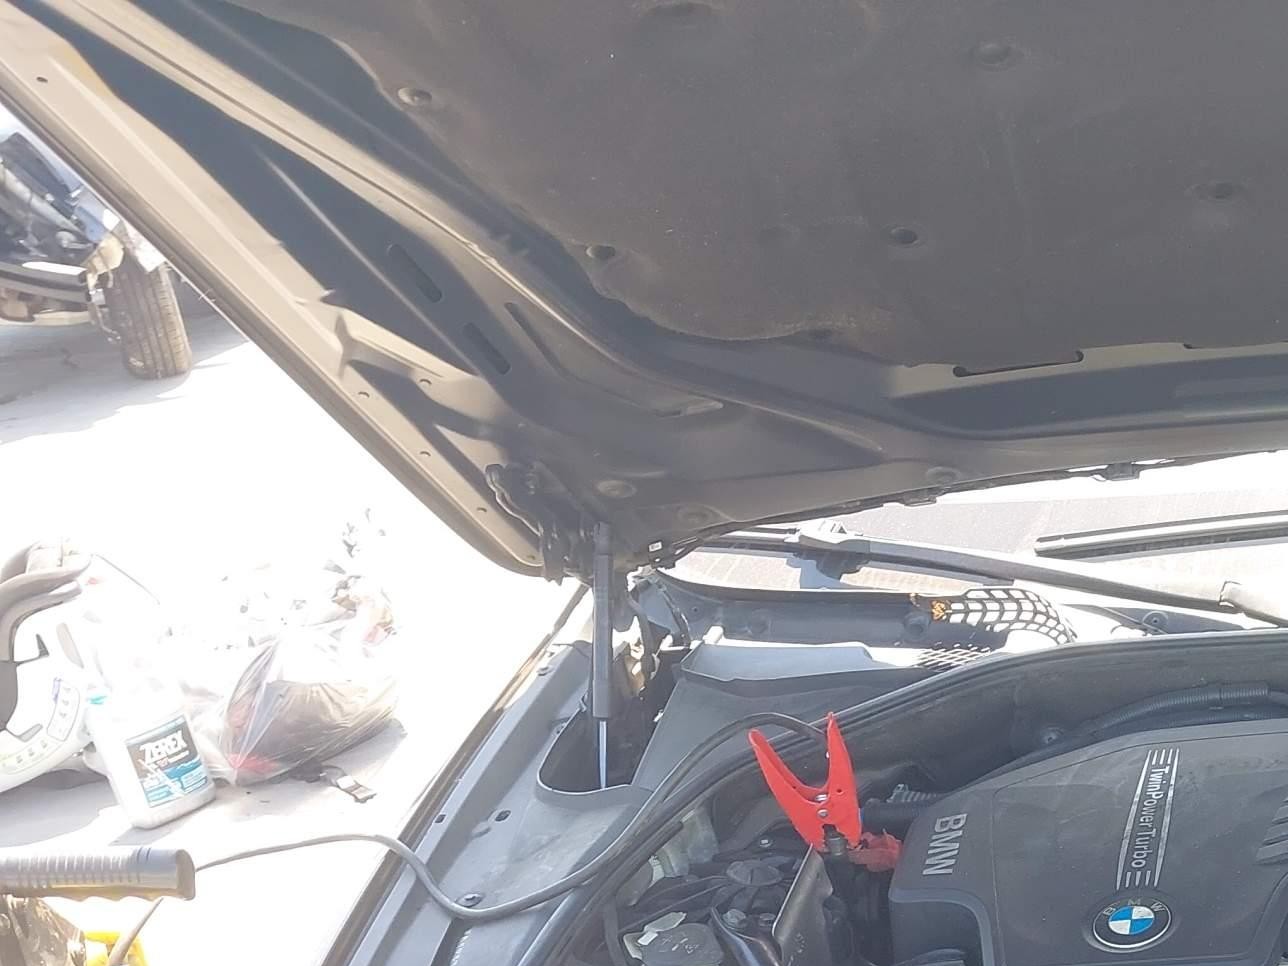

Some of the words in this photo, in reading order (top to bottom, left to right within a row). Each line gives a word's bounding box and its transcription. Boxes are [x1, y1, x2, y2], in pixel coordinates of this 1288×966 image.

[138, 729, 189, 764] ZEREX
[922, 812, 968, 876] BMW
[1131, 764, 1170, 869] TwinPowerTurbo
